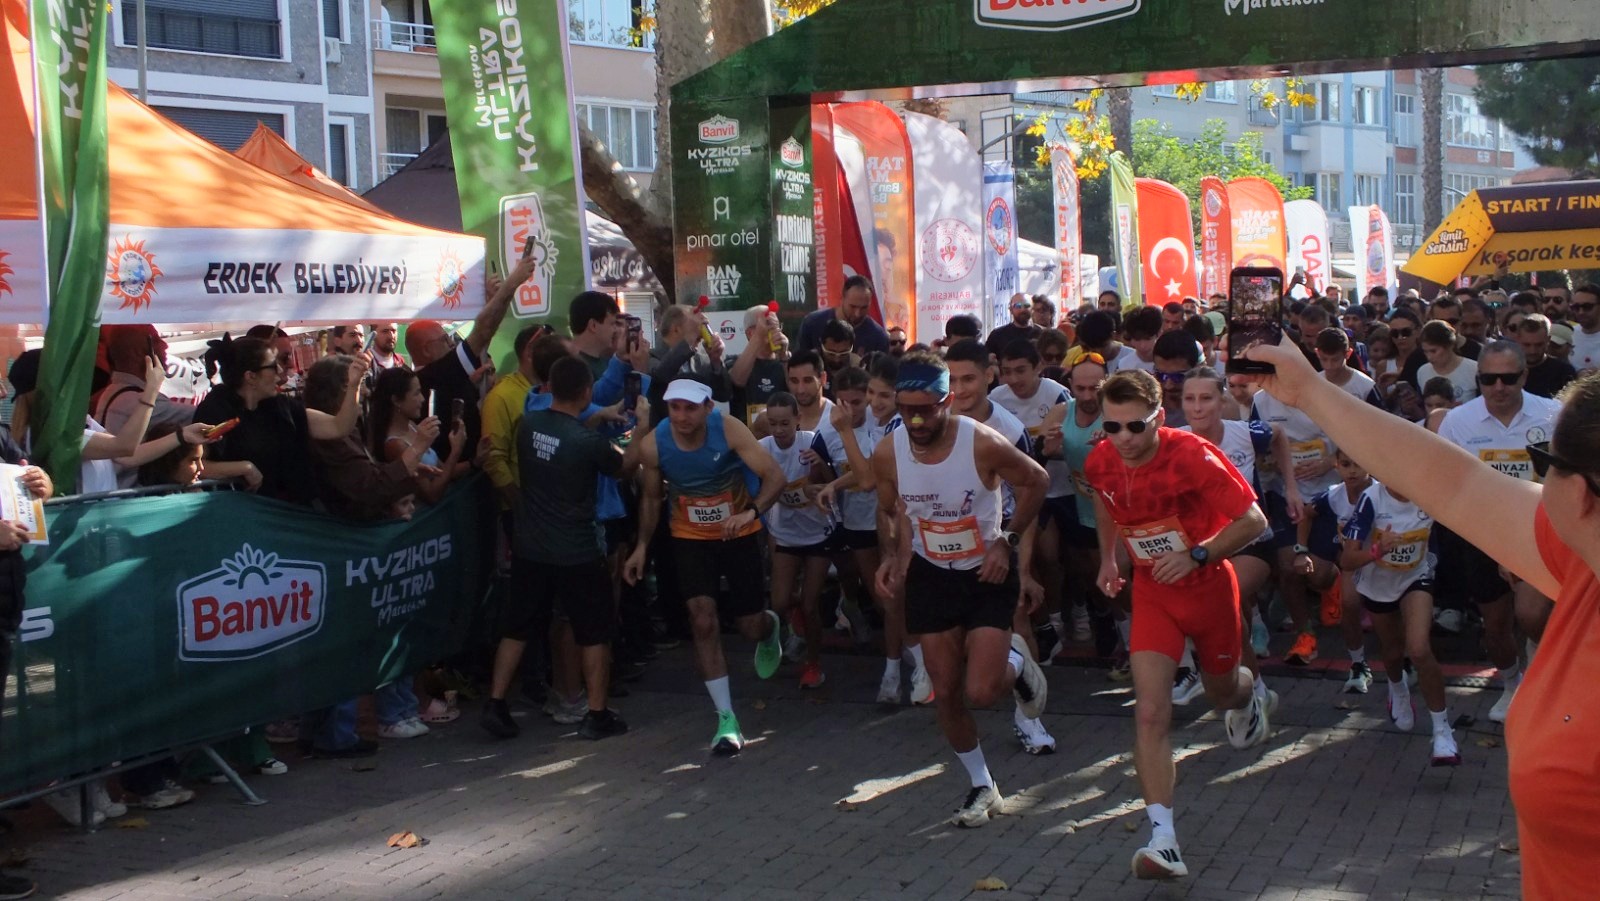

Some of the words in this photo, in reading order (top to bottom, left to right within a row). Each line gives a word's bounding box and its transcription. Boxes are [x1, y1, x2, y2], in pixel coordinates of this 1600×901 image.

[702, 125, 735, 138] Banvit
[687, 145, 751, 160] KYZIKOS
[782, 147, 801, 161] Banvit
[700, 157, 740, 169] ULTRA
[775, 168, 811, 184] KYZIKOS
[782, 181, 805, 194] ULTRA
[1487, 198, 1550, 215] START
[730, 228, 760, 246] otel
[1439, 228, 1465, 244] Limit
[1425, 238, 1470, 256] Sensin!
[203, 261, 283, 294] ERDEK
[293, 257, 407, 296] BELEDİYESİ
[706, 264, 736, 280] BAN
[710, 279, 740, 295] KEV
[787, 274, 806, 304] KOŞ
[720, 326, 736, 334] MTN
[1491, 462, 1529, 472] NİYAZİ
[901, 493, 940, 502] ACADEMY
[694, 508, 723, 516] BİLAL
[938, 543, 963, 552] 1122
[1138, 536, 1171, 549] BERK
[345, 533, 452, 587] KYZIKOS
[1391, 554, 1411, 563] 529
[370, 570, 435, 608] ULTRA
[192, 580, 313, 642] Banvit
